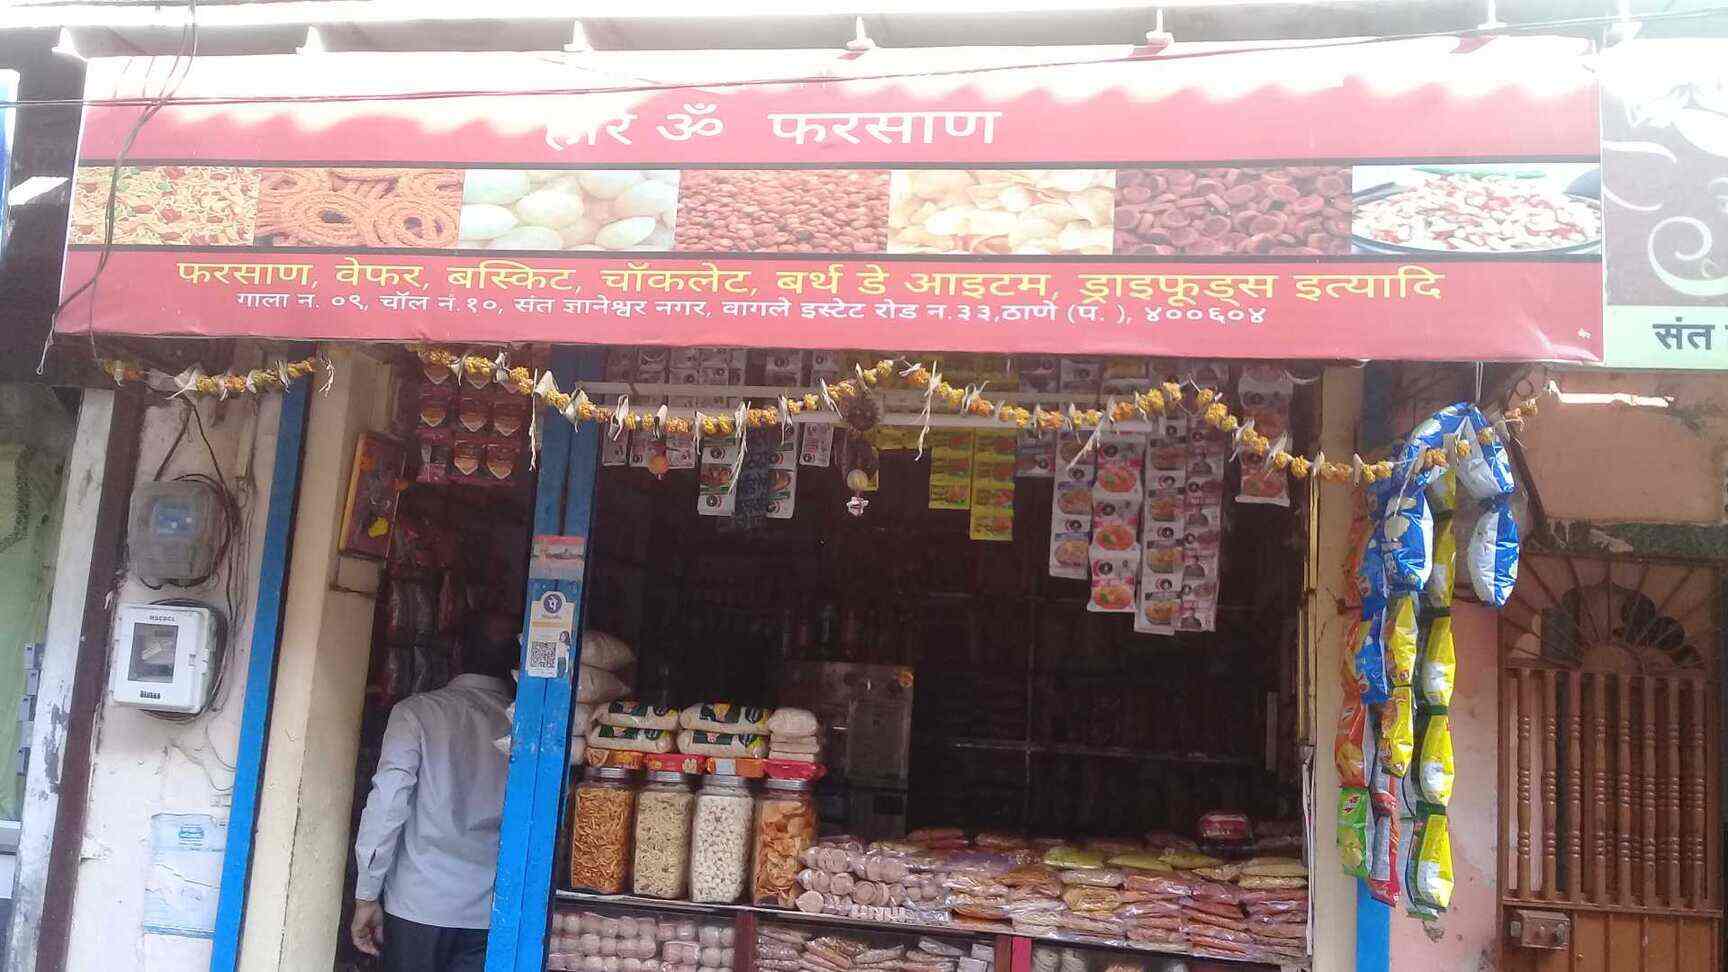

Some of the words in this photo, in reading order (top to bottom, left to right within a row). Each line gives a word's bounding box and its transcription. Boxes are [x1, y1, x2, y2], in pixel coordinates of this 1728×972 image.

[767, 111, 1003, 144] फरसाण
[177, 263, 318, 288] फरसाण,
[335, 256, 429, 290] वेफर,
[447, 259, 582, 293] बस्किट,
[600, 262, 757, 297] चॉकलेट,
[776, 264, 844, 294] बर्थ
[856, 265, 890, 295] डे
[905, 272, 1059, 301] आइटम,
[1078, 274, 1280, 307] ड्राइफूड्स
[1293, 265, 1446, 300] इत्यादि
[236, 293, 290, 308] गाला
[379, 290, 430, 310] चॉल
[513, 295, 556, 314] संत
[563, 295, 648, 318] ज्ञानेश्वर
[655, 300, 713, 318] नगर,
[722, 297, 793, 317] वागले
[800, 298, 867, 319] इस्टेट
[875, 298, 919, 320] रोड
[1144, 306, 1267, 325] ४००६०४
[1651, 316, 1716, 350] संत
